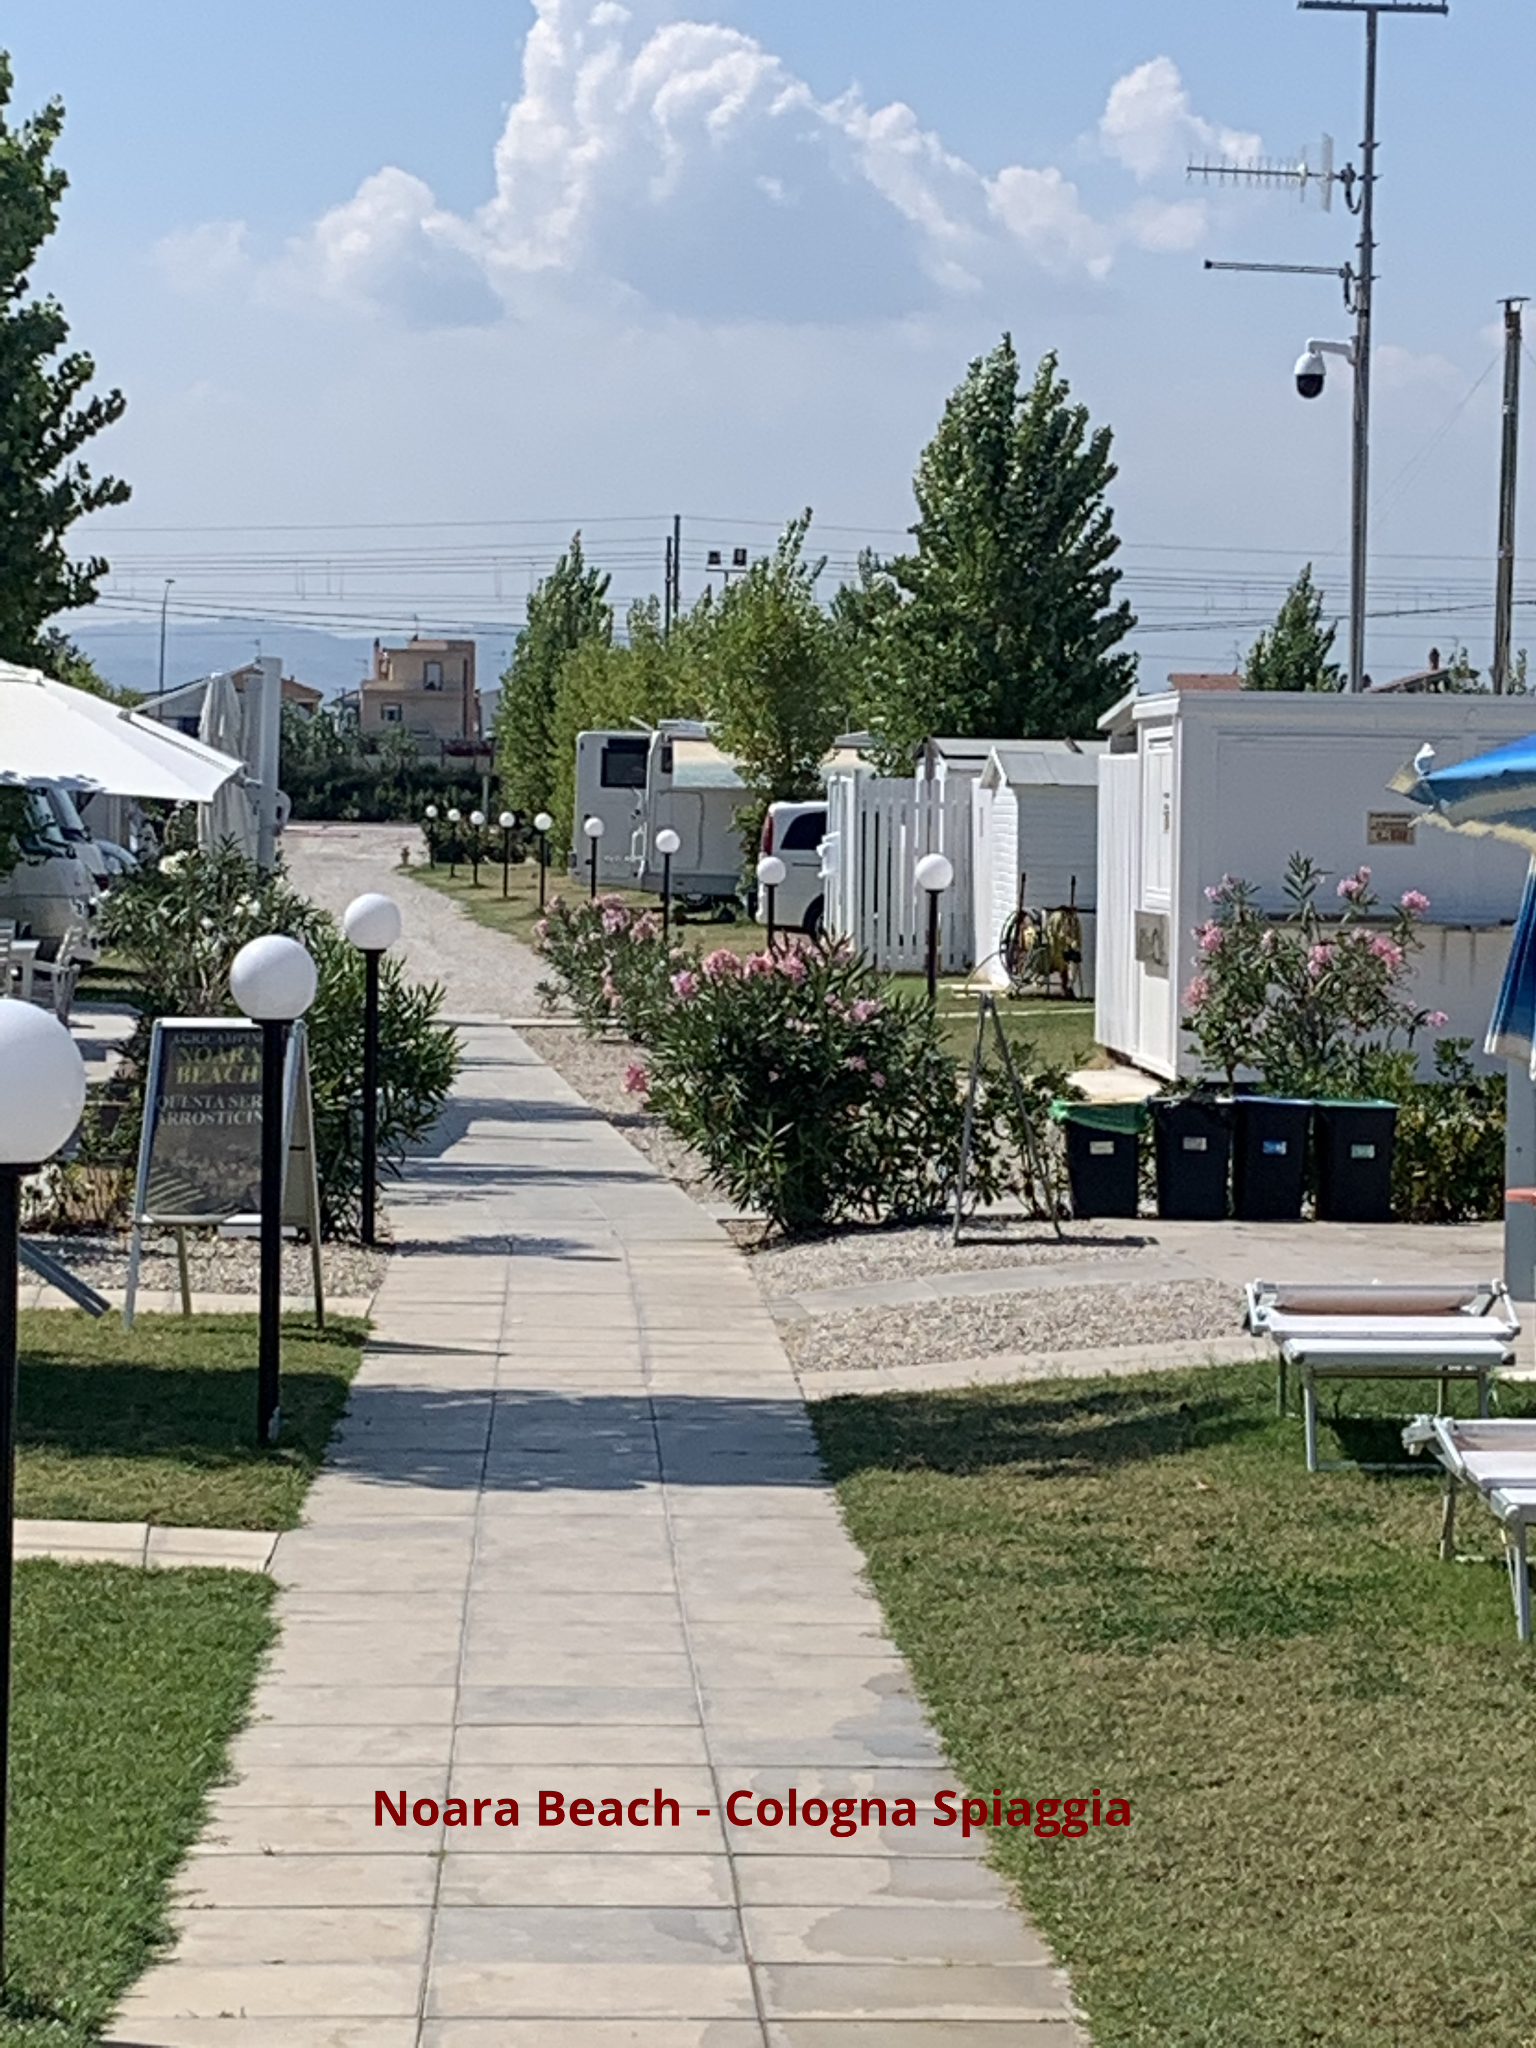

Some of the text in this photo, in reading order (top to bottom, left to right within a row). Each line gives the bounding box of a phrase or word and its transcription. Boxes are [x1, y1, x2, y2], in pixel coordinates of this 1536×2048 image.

[173, 1034, 263, 1045] AGRICAMPIN
[177, 1066, 260, 1084] BEACH
[157, 1094, 263, 1111] QUESTA SER
[158, 1109, 263, 1125] ARROSTICIN
